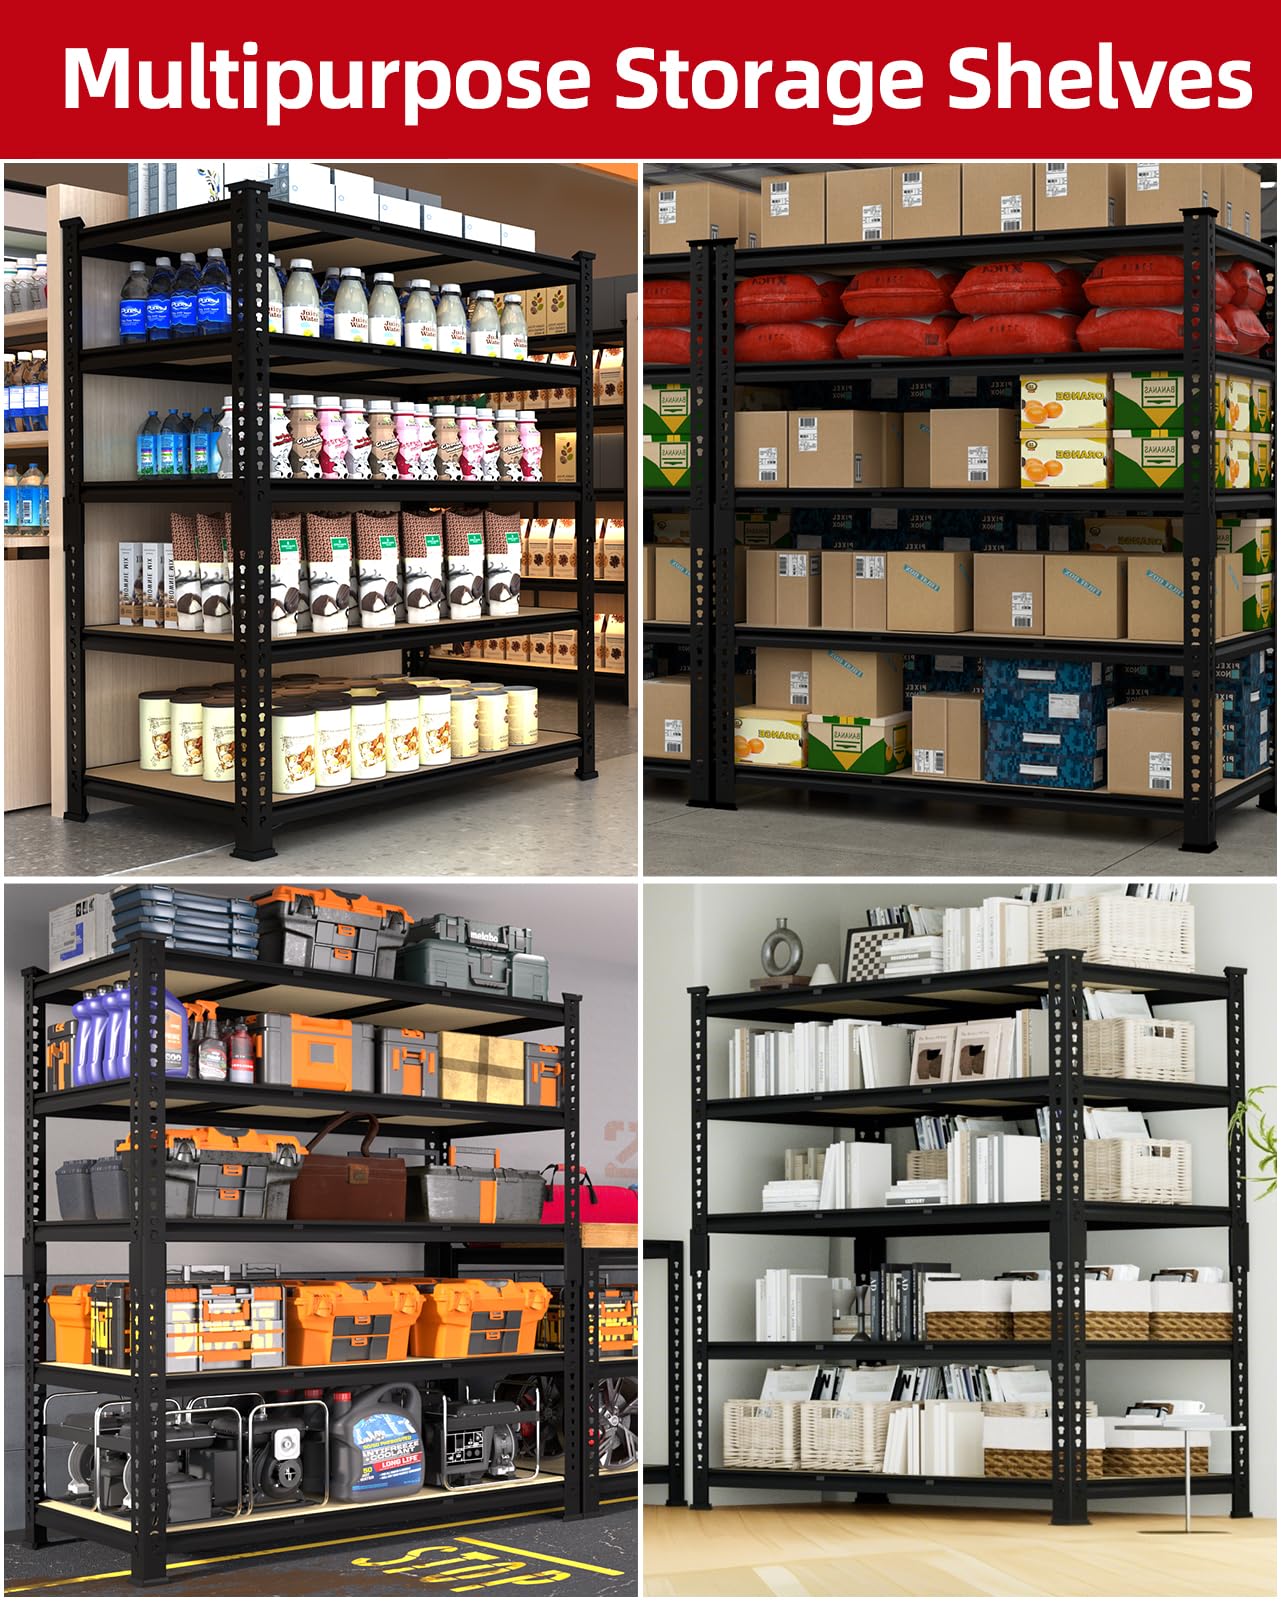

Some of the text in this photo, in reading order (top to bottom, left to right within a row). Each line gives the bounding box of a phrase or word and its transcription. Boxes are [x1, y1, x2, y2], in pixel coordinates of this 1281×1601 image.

[470, 930, 499, 943] metabo
[381, 1454, 418, 1469] LONG LIFE
[351, 1545, 572, 1593] STOP
